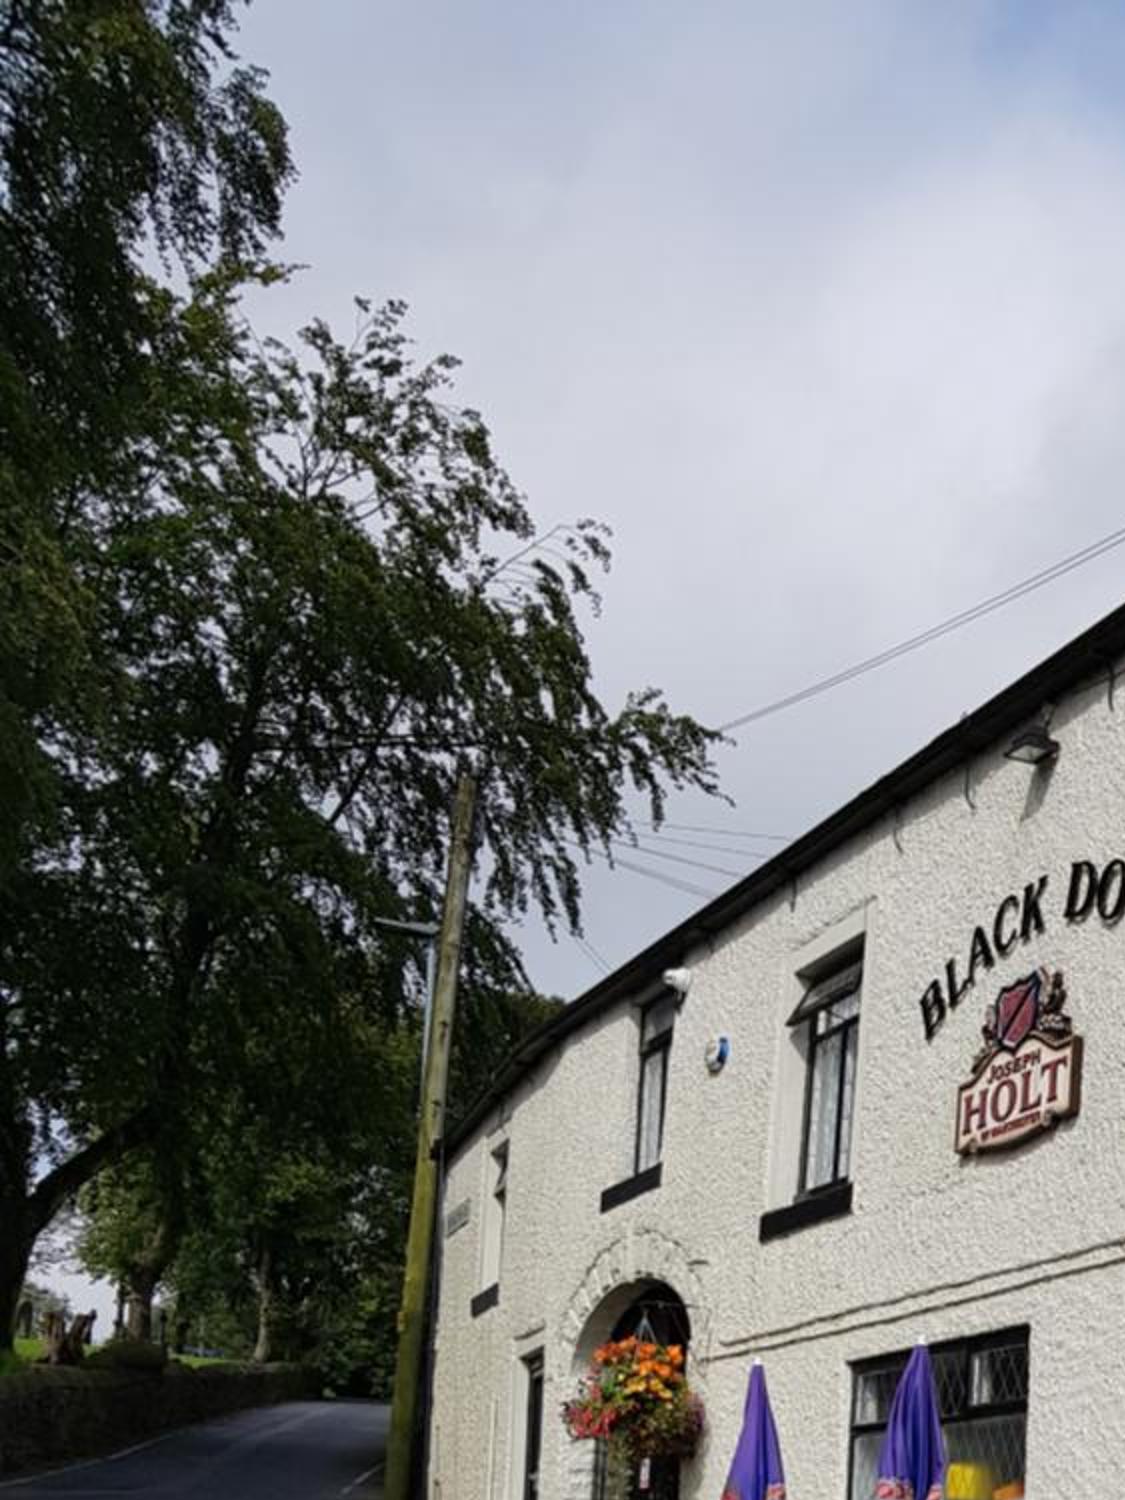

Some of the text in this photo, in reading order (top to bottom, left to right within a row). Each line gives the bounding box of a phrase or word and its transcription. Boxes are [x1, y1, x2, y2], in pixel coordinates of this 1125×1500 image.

[919, 875, 1048, 1041] BLACK
[962, 1055, 1068, 1136] HOLT
[988, 1049, 1041, 1084] JOSEPH
